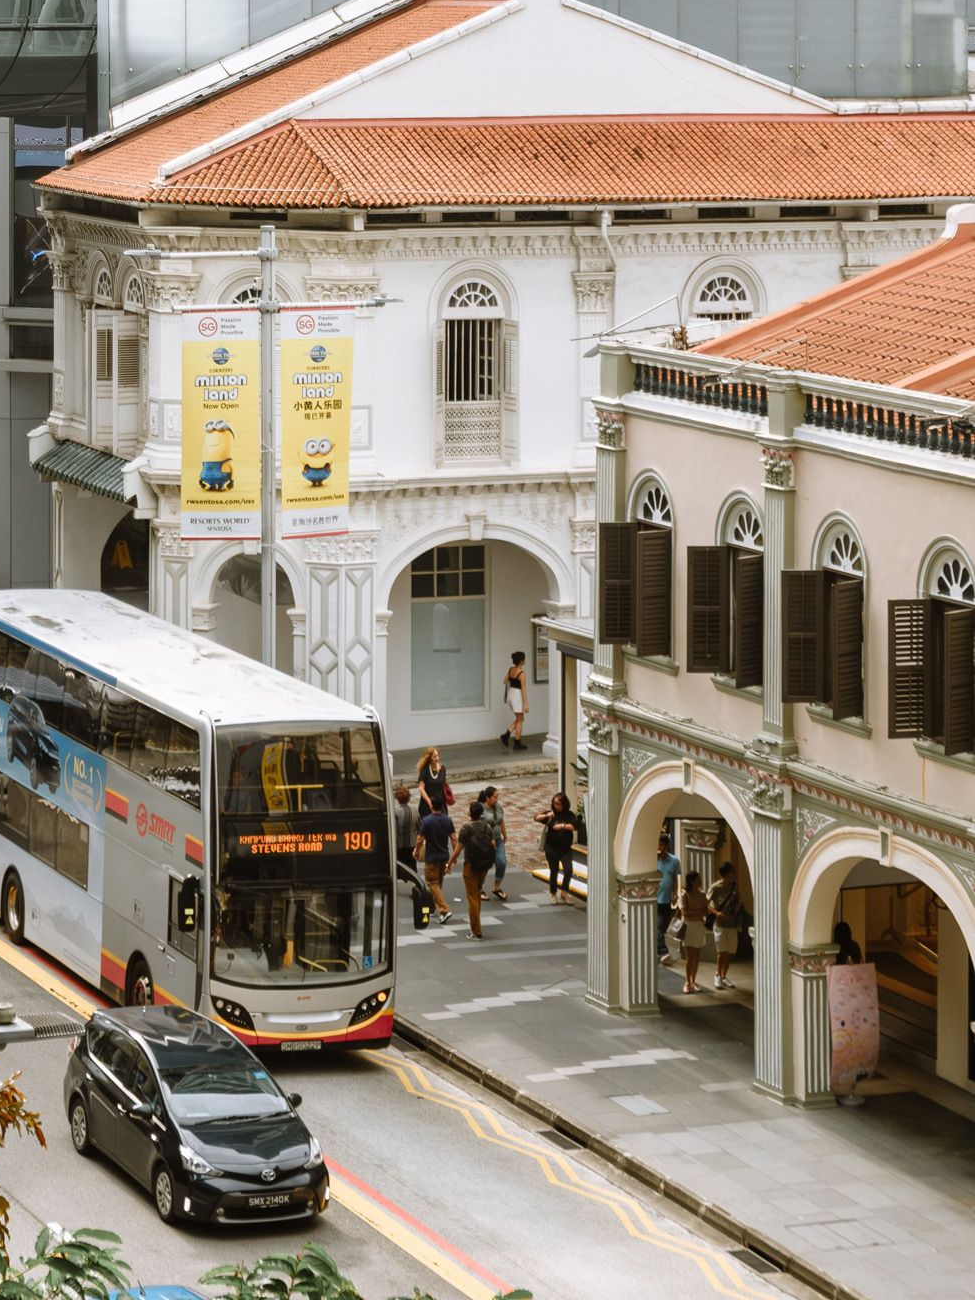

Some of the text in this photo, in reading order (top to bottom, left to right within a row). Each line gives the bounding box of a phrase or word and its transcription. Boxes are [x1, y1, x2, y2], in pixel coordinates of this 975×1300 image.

[201, 322, 215, 331] SG
[299, 320, 313, 329] SG
[194, 374, 247, 387] minion
[293, 372, 343, 385] minion
[204, 387, 238, 401] land
[302, 385, 335, 399] land
[294, 399, 343, 411] 小黄人乐园
[286, 494, 345, 503] rwsentosa.com/uss
[190, 517, 221, 525] RESORTS
[343, 831, 372, 851] 190
[251, 842, 323, 854] STEVENS ROAD
